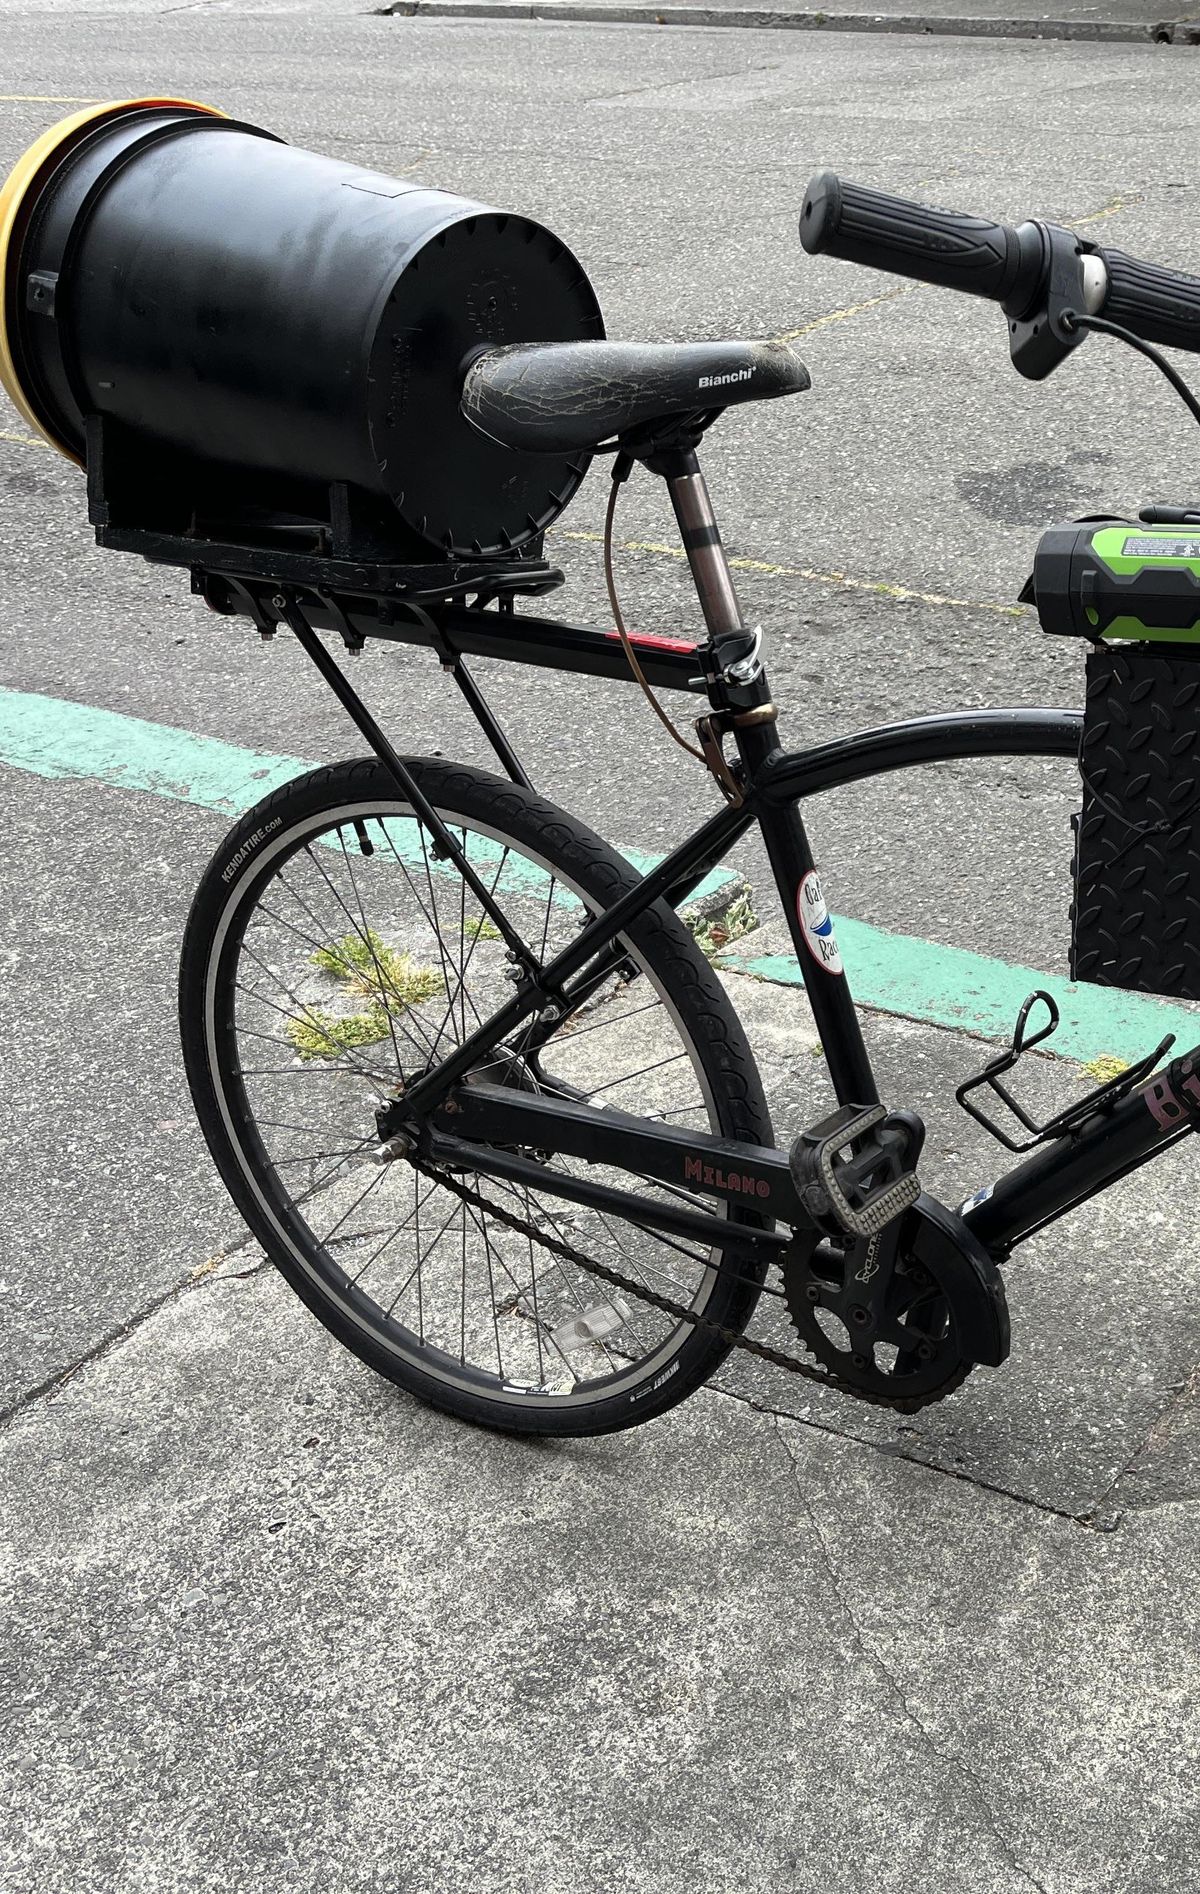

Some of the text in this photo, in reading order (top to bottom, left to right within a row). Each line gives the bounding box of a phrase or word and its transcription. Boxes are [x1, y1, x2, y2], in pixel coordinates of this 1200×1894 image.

[699, 367, 752, 388] Bianchi
[221, 816, 283, 883] KENDATIRE.COM
[684, 1156, 770, 1198] MILANO
